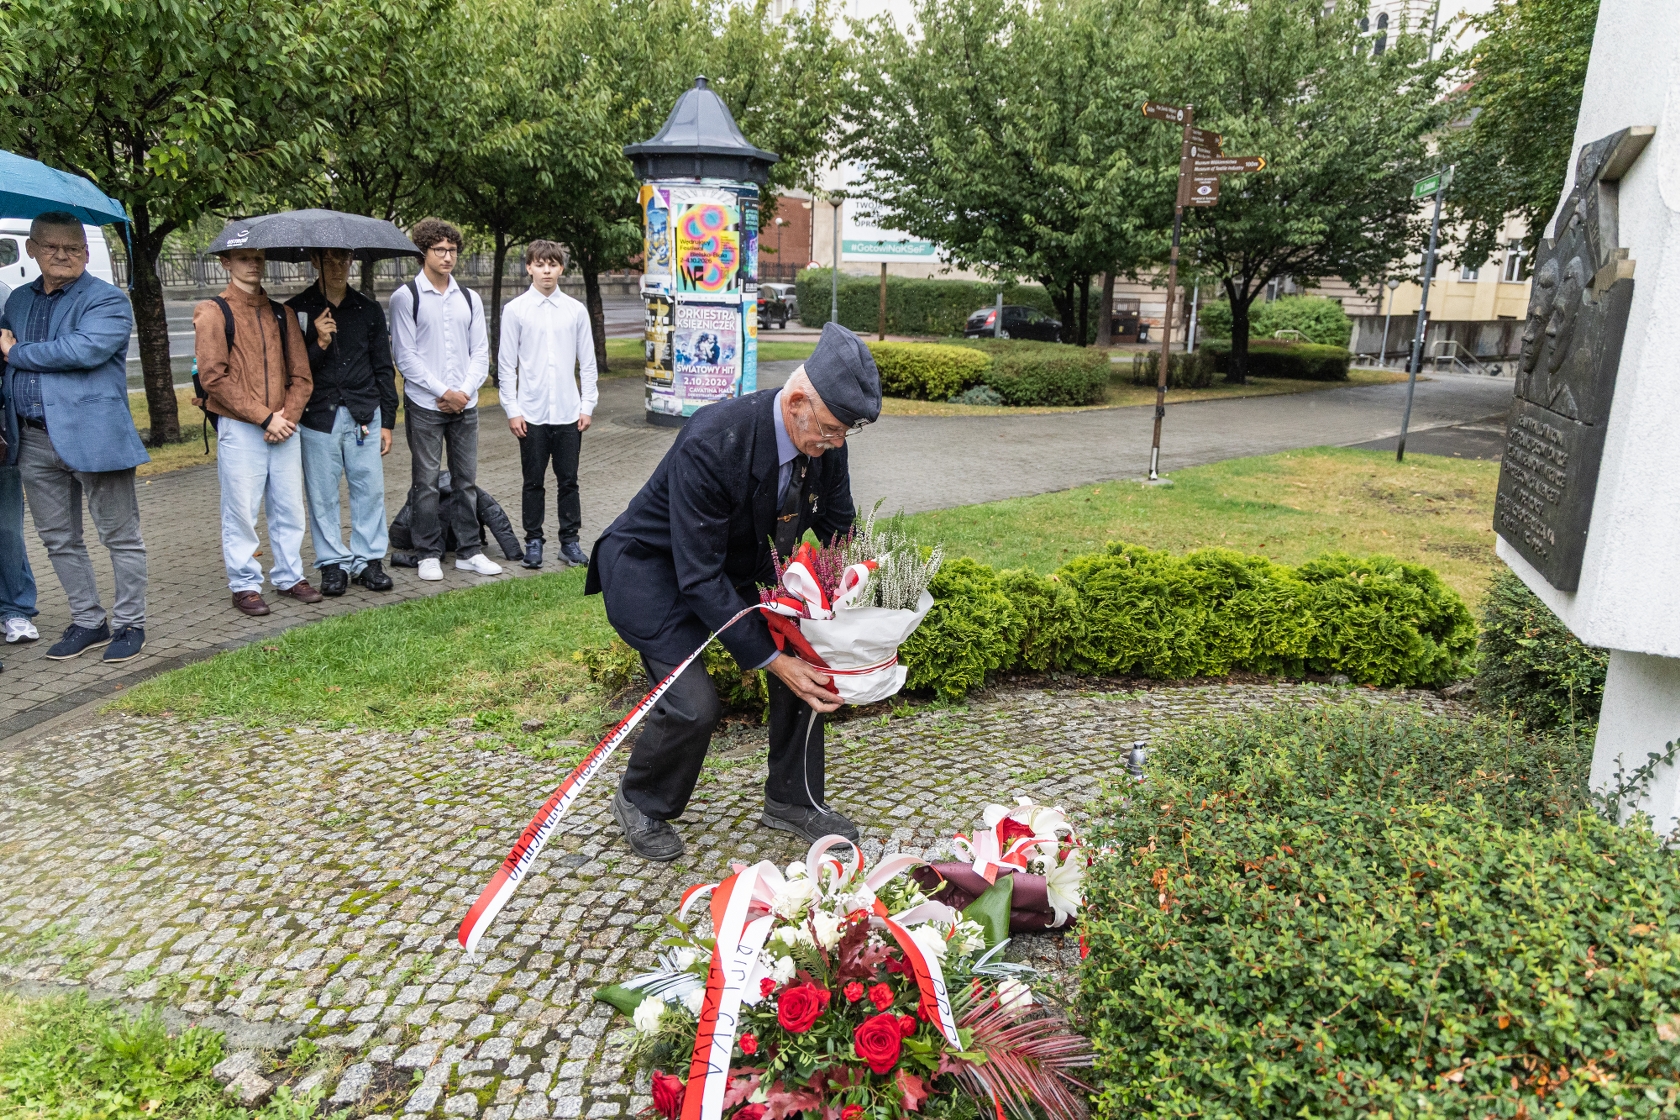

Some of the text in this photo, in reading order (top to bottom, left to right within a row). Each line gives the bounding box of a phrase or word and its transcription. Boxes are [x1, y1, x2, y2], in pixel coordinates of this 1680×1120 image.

[851, 243, 926, 254] #GotowiNaKSeF
[677, 308, 736, 321] ORKIESTRA
[722, 366, 735, 375] HIT
[683, 377, 728, 387] 2.10.2026
[501, 789, 571, 882] LOTNICTWA
